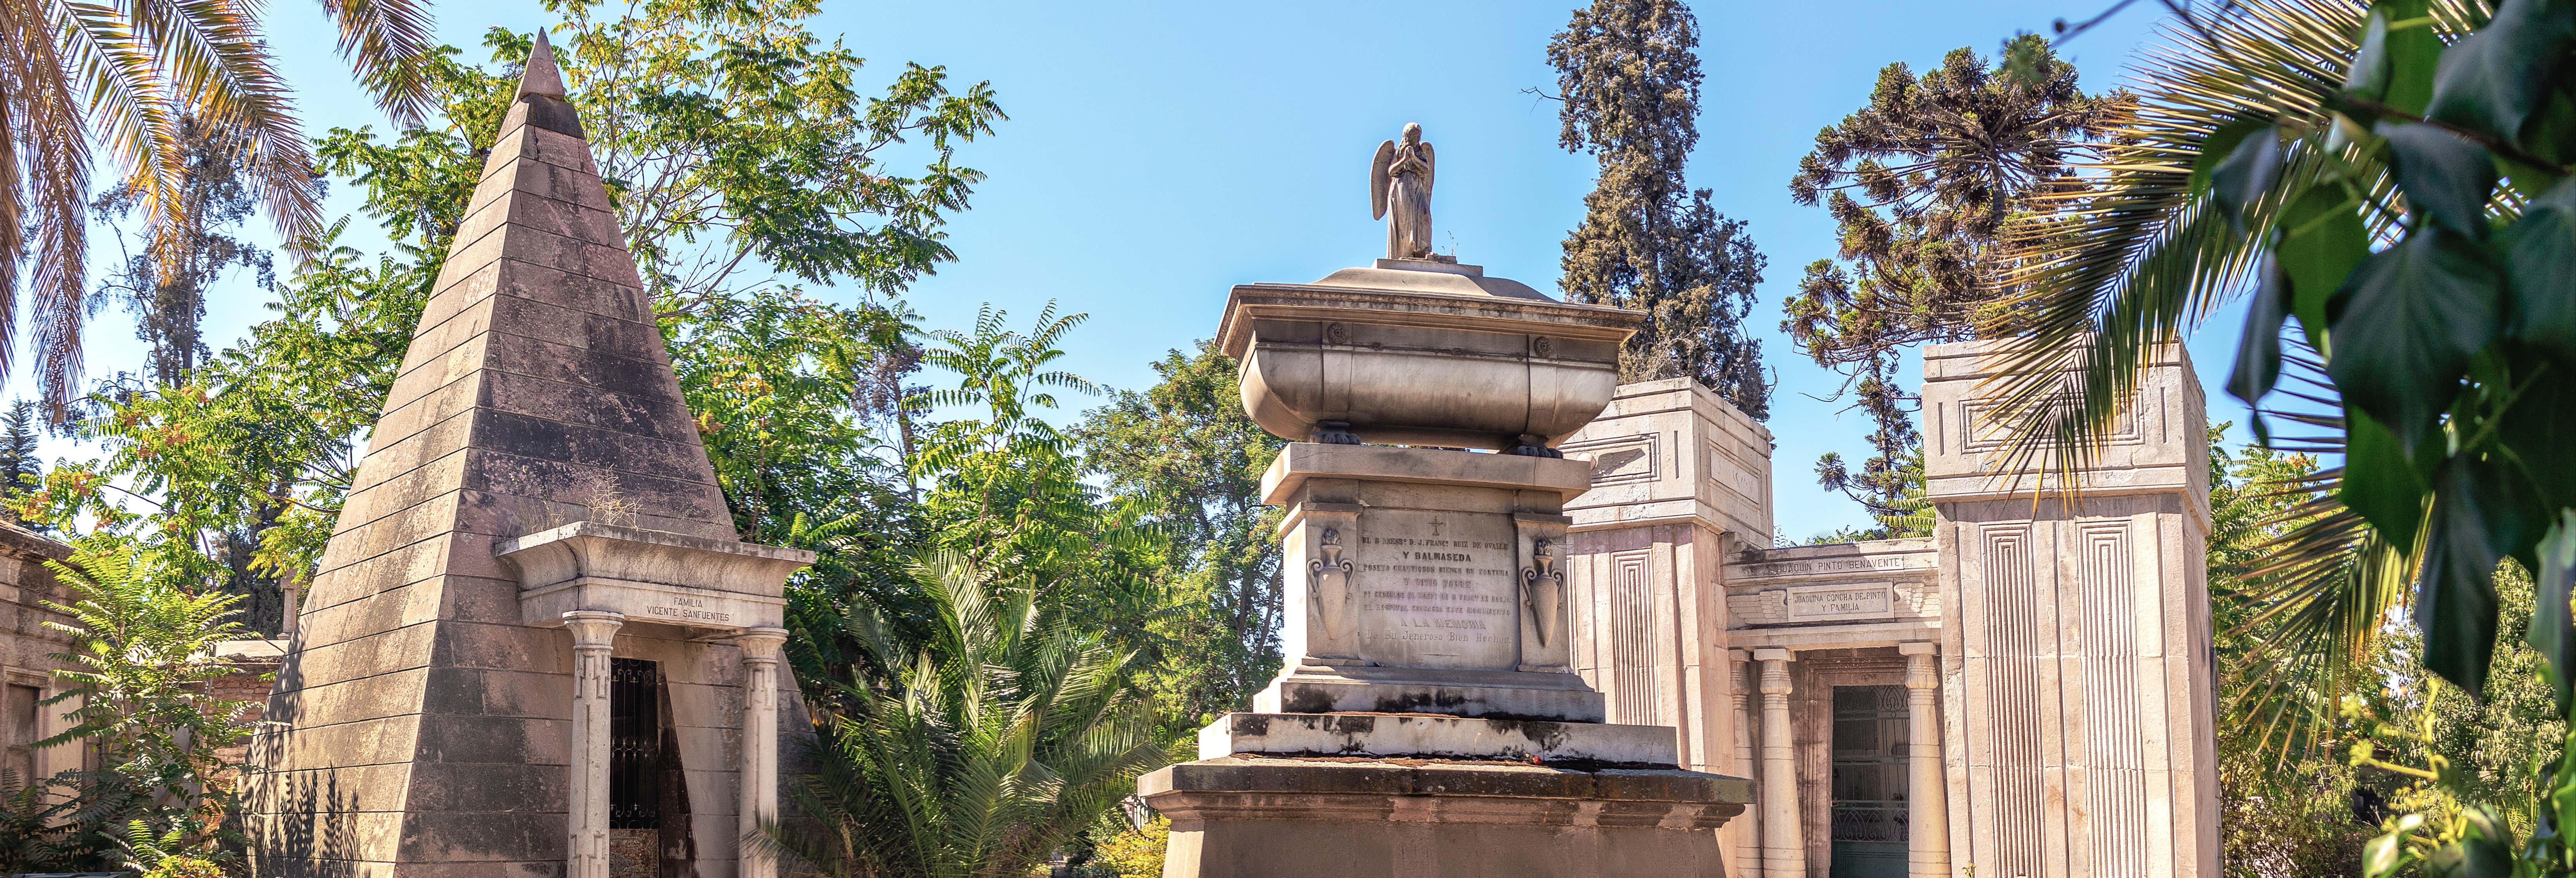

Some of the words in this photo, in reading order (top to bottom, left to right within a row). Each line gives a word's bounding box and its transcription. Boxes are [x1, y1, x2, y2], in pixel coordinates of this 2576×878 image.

[1415, 552, 1471, 562] BALMASEDA
[1818, 561, 1842, 570] PINTO
[1849, 558, 1899, 569] BENAVENTE
[1827, 593, 1854, 602] CONCHA
[1867, 591, 1886, 600] PINTO
[674, 597, 702, 608] FAMILIA
[647, 606, 678, 616] VICENTE
[683, 609, 729, 621] SANFUENTES
[1401, 618, 1408, 626] A
[1413, 618, 1430, 627] LA
[1434, 618, 1486, 629] MEMORIA
